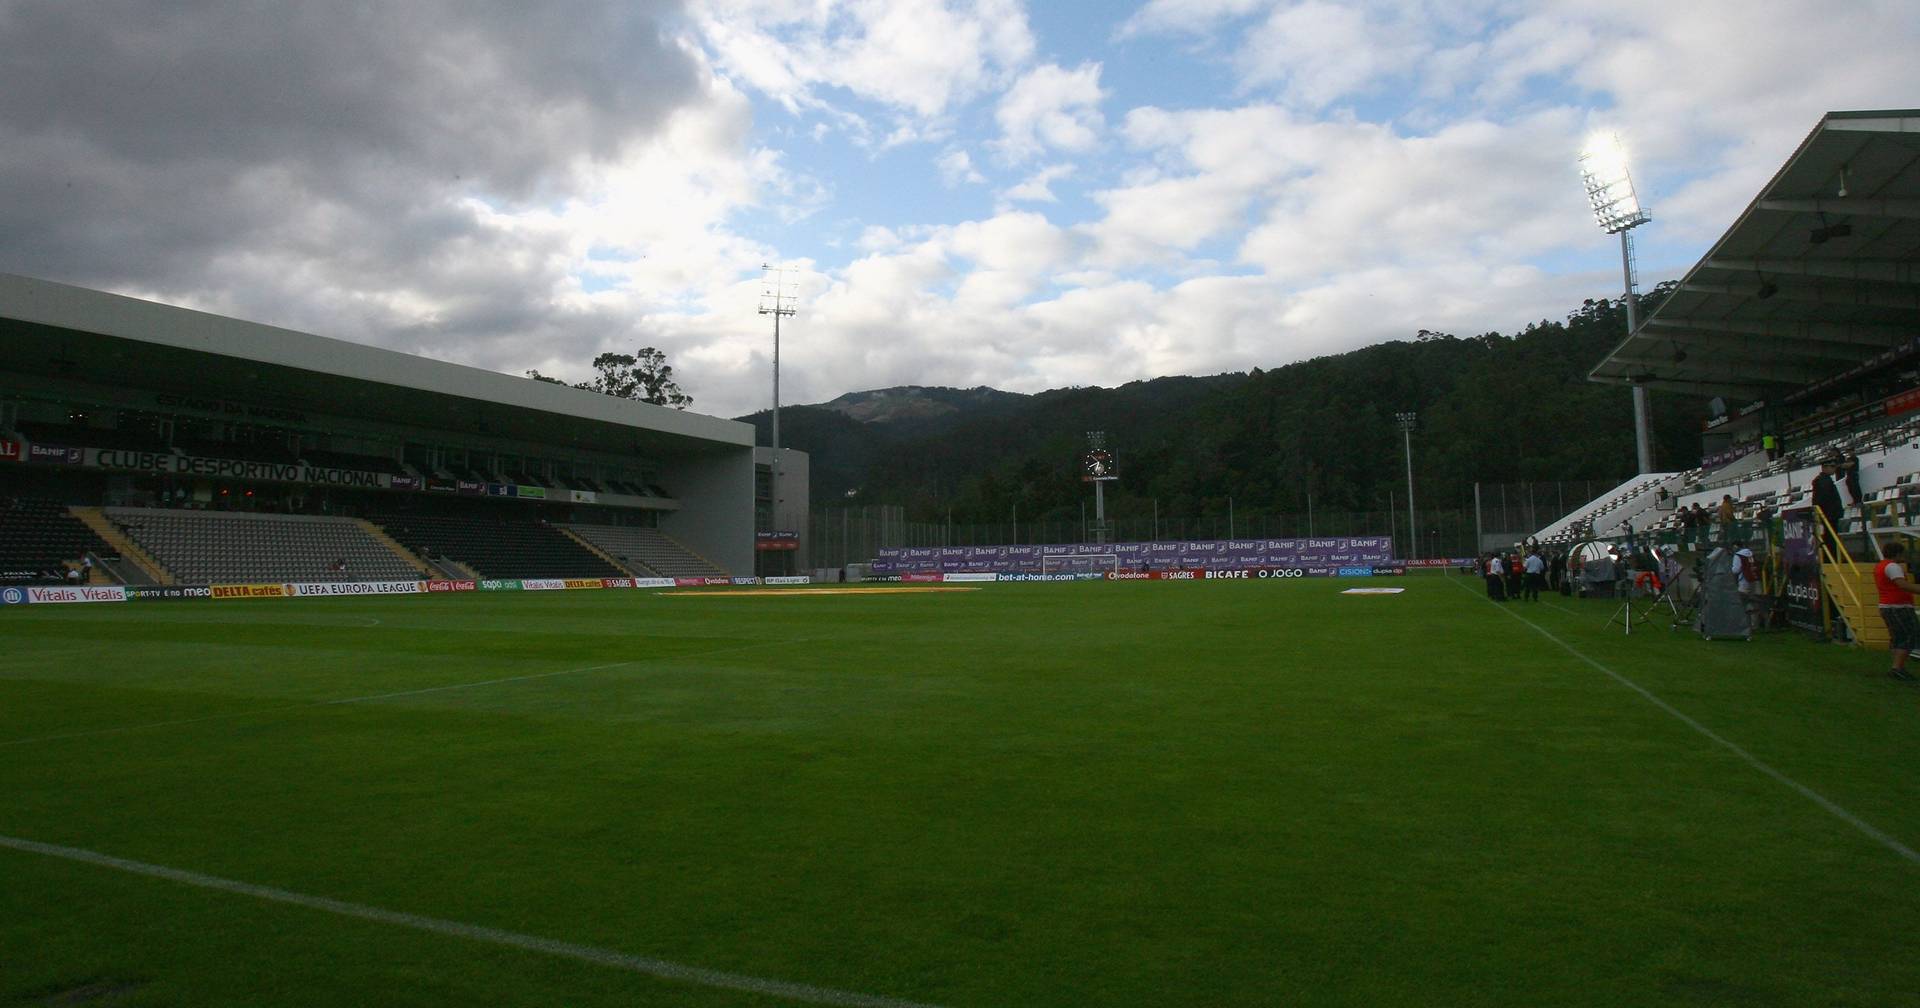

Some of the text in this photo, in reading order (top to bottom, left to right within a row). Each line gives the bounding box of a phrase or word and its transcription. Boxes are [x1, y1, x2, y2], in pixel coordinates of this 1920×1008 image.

[32, 445, 65, 456] BANIF
[97, 450, 382, 488] CLUBE DESPORTIVO NACIONAL
[1783, 520, 1804, 539] BANIF
[998, 572, 1074, 581] bet-at-home.com
[1270, 569, 1303, 578] JOGO
[184, 587, 211, 597] meo
[213, 586, 282, 597] DELTA cafés
[299, 582, 416, 595] UEFA EUROPA LEAGUE
[482, 581, 502, 592] sapo
[32, 587, 123, 601] Vitalis Vitalis
